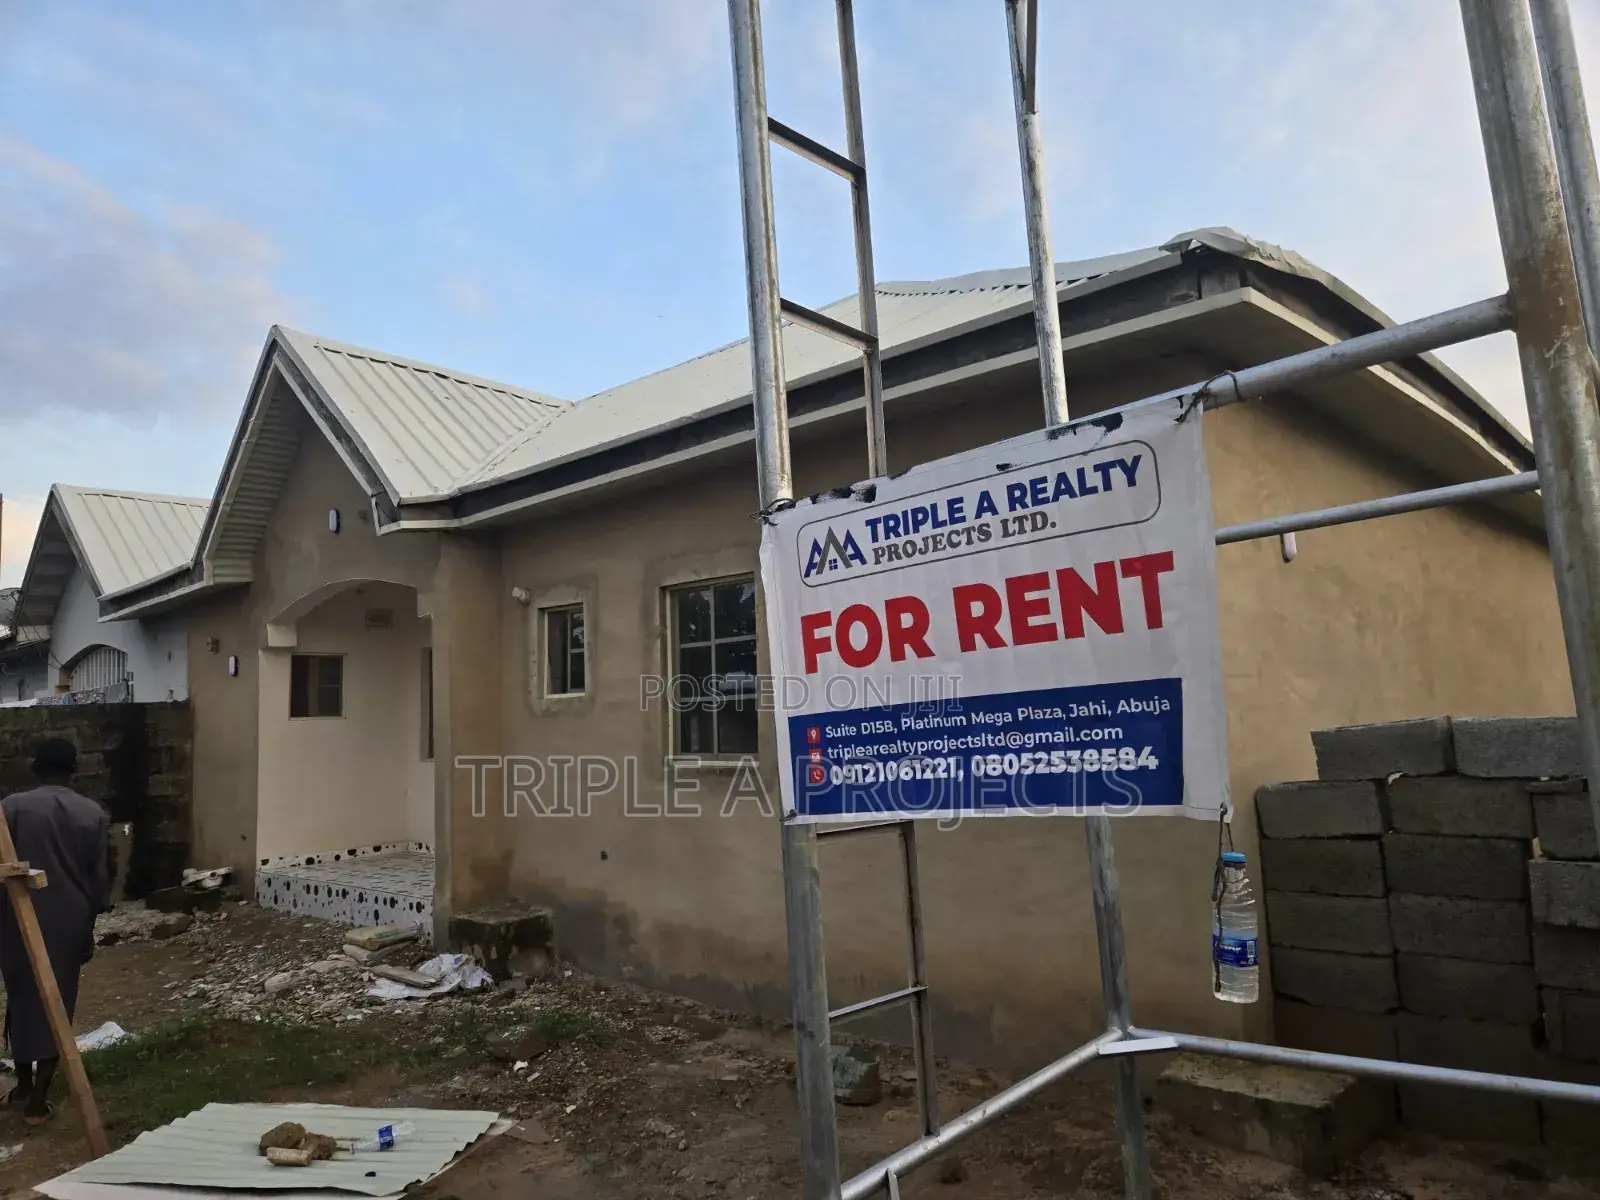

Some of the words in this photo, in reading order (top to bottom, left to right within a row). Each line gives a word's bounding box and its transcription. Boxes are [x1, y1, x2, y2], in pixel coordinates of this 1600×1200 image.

[865, 496, 966, 544] TRIPLE
[974, 490, 999, 519] A
[1006, 454, 1143, 512] REALTY
[872, 523, 992, 565] PROJECTS
[999, 510, 1057, 539] LTD.
[800, 595, 936, 674] FOR
[953, 550, 1174, 653] RENT
[825, 725, 857, 738] Suite
[861, 720, 898, 735] D15B,
[901, 714, 967, 731] Platinum
[971, 711, 1012, 726] Mega
[1017, 706, 1066, 721] Plaza,
[1069, 699, 1112, 718] Jahi,
[1116, 695, 1171, 714] Abuja
[827, 726, 1123, 761] triplearealtyprojectsltd@gmail.com
[830, 757, 964, 785] 09121061221,
[971, 746, 1159, 777] 08052538584
